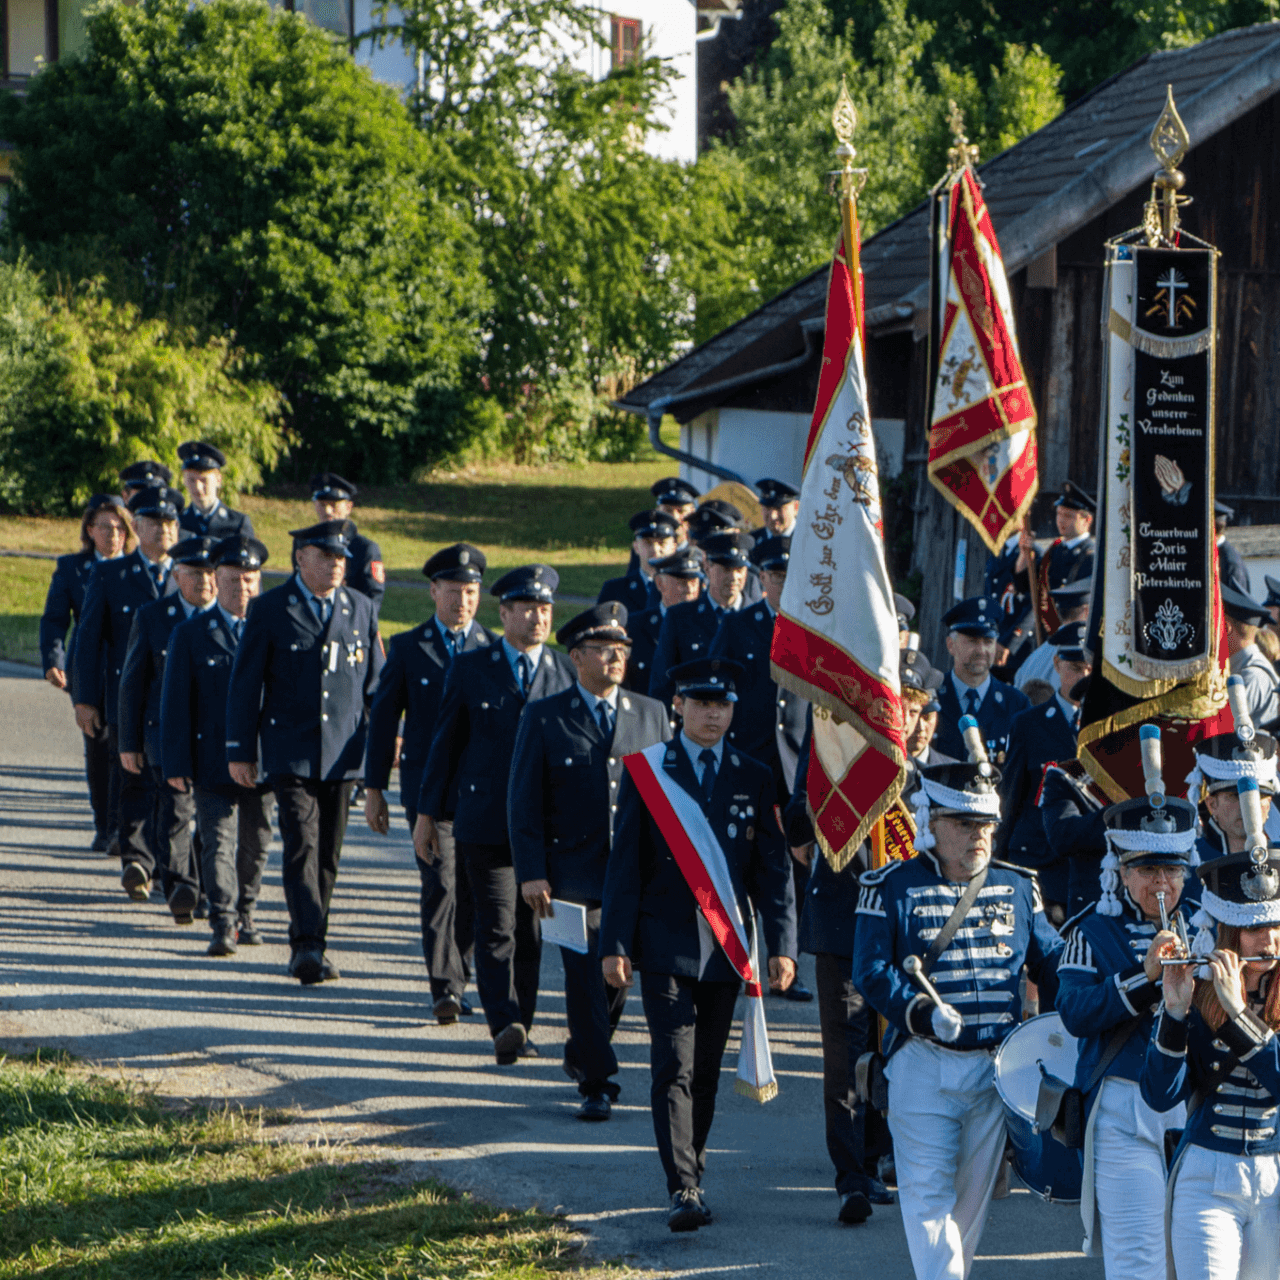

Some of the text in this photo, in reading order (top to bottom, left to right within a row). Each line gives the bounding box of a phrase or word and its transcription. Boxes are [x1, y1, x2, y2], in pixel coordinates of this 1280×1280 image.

[1160, 370, 1184, 388] Zum
[1146, 388, 1195, 406] Gedenken
[1151, 410, 1188, 419] unserer
[1138, 418, 1202, 436] Verstorbenen
[1138, 521, 1199, 538] Trauerbraut
[1150, 538, 1187, 556] Doris
[819, 545, 838, 570] zur
[1149, 556, 1188, 572] Maier
[1134, 572, 1202, 590] Peterskirchen
[805, 572, 834, 616] Gott
